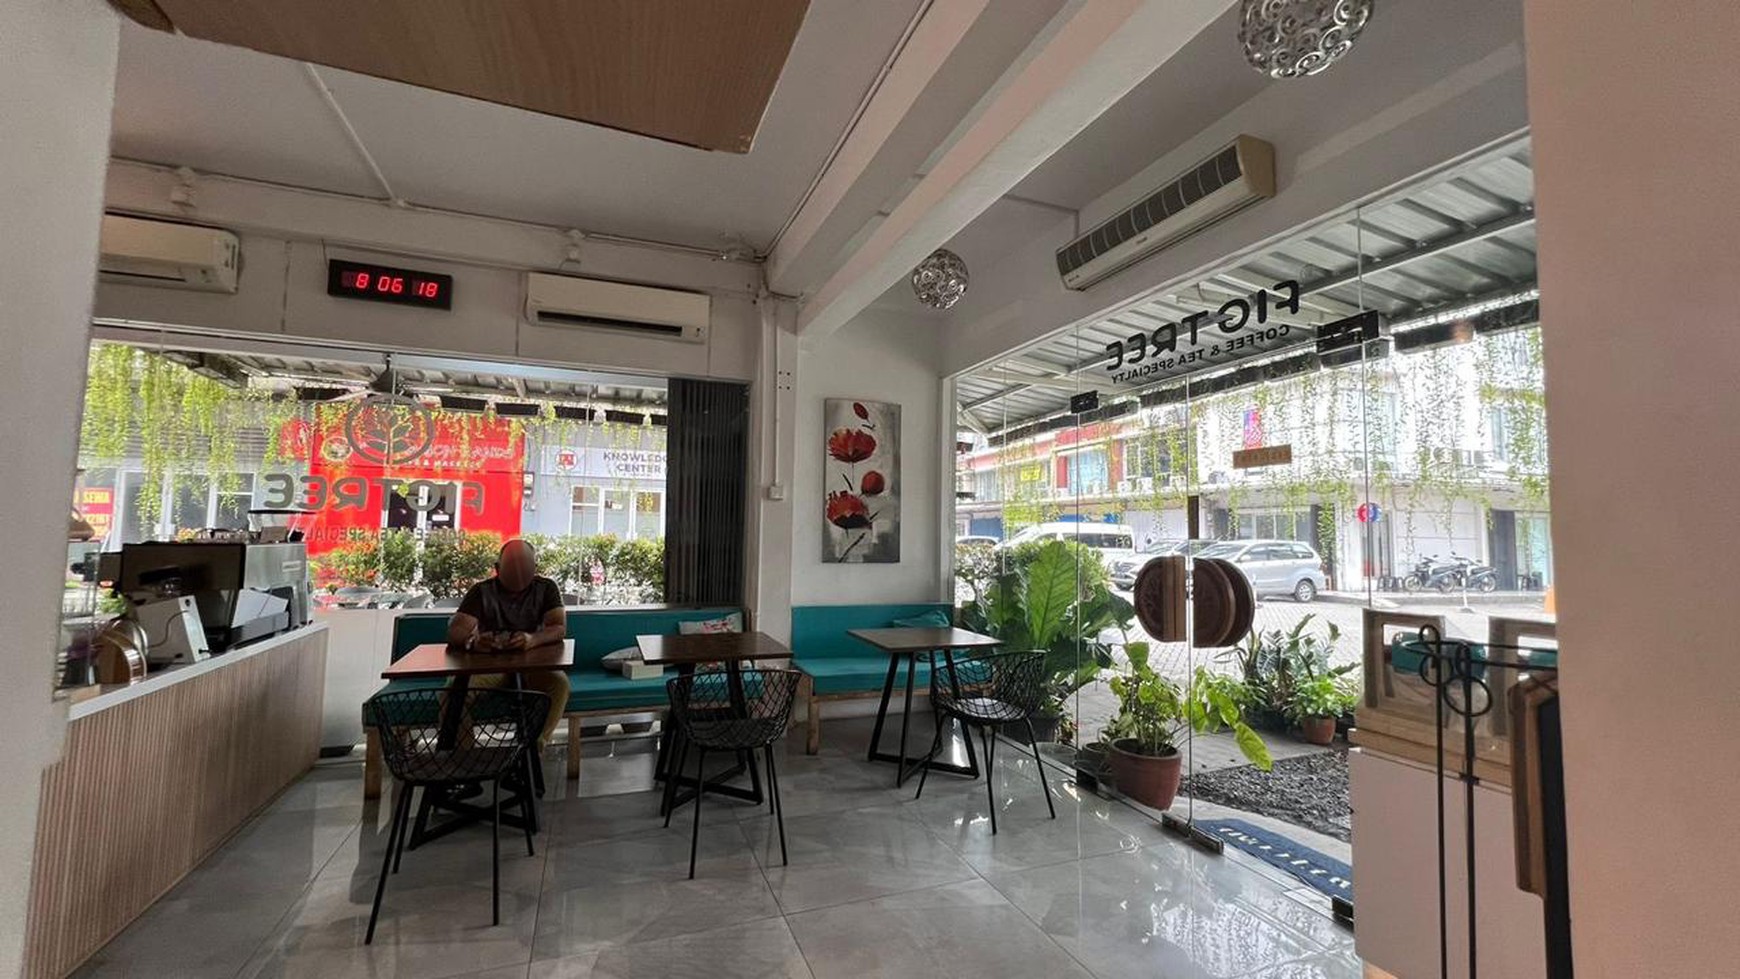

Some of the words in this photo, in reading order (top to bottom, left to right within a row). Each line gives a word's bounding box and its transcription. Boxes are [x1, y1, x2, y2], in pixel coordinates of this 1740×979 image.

[356, 272, 369, 289] 8
[377, 276, 403, 293] 06
[418, 282, 438, 298] 18
